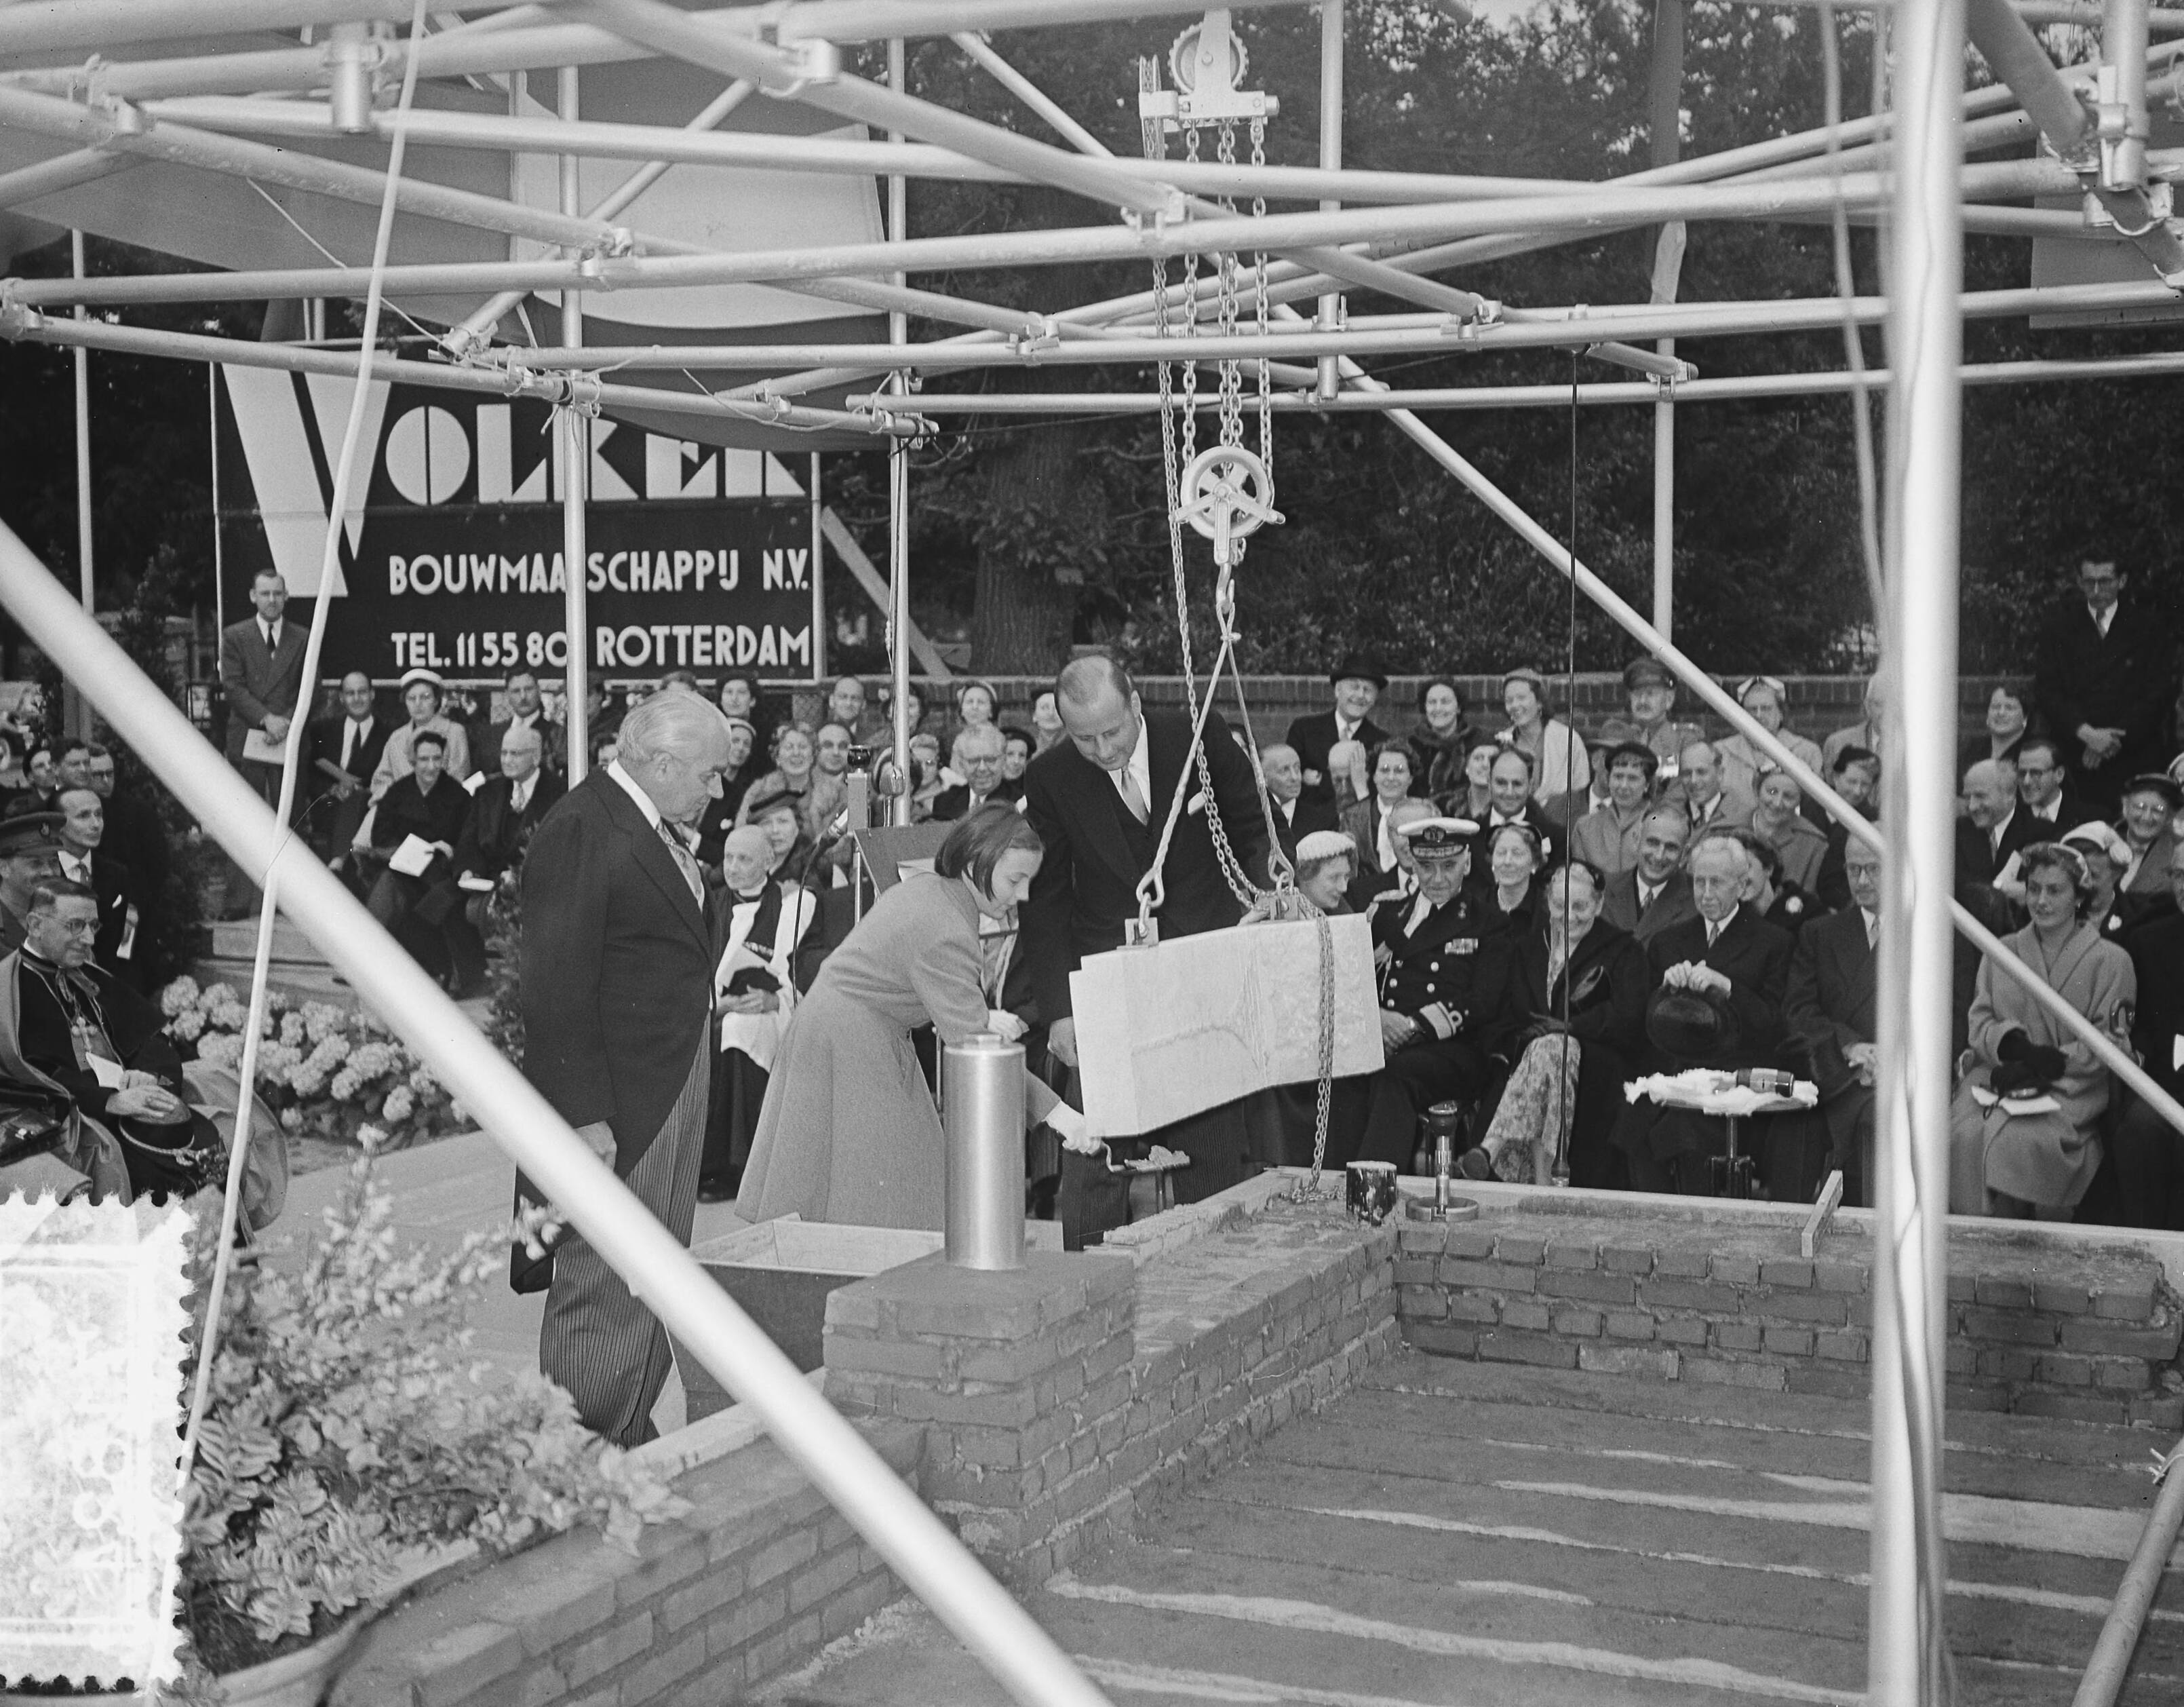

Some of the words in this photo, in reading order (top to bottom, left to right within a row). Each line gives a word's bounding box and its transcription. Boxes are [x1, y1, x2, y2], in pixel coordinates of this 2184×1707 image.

[389, 550, 739, 594] BOUWMAASCHAPPIJ
[763, 548, 809, 591] N.V.
[391, 632, 451, 668] TEL.
[596, 624, 811, 667] ROTTERDAM
